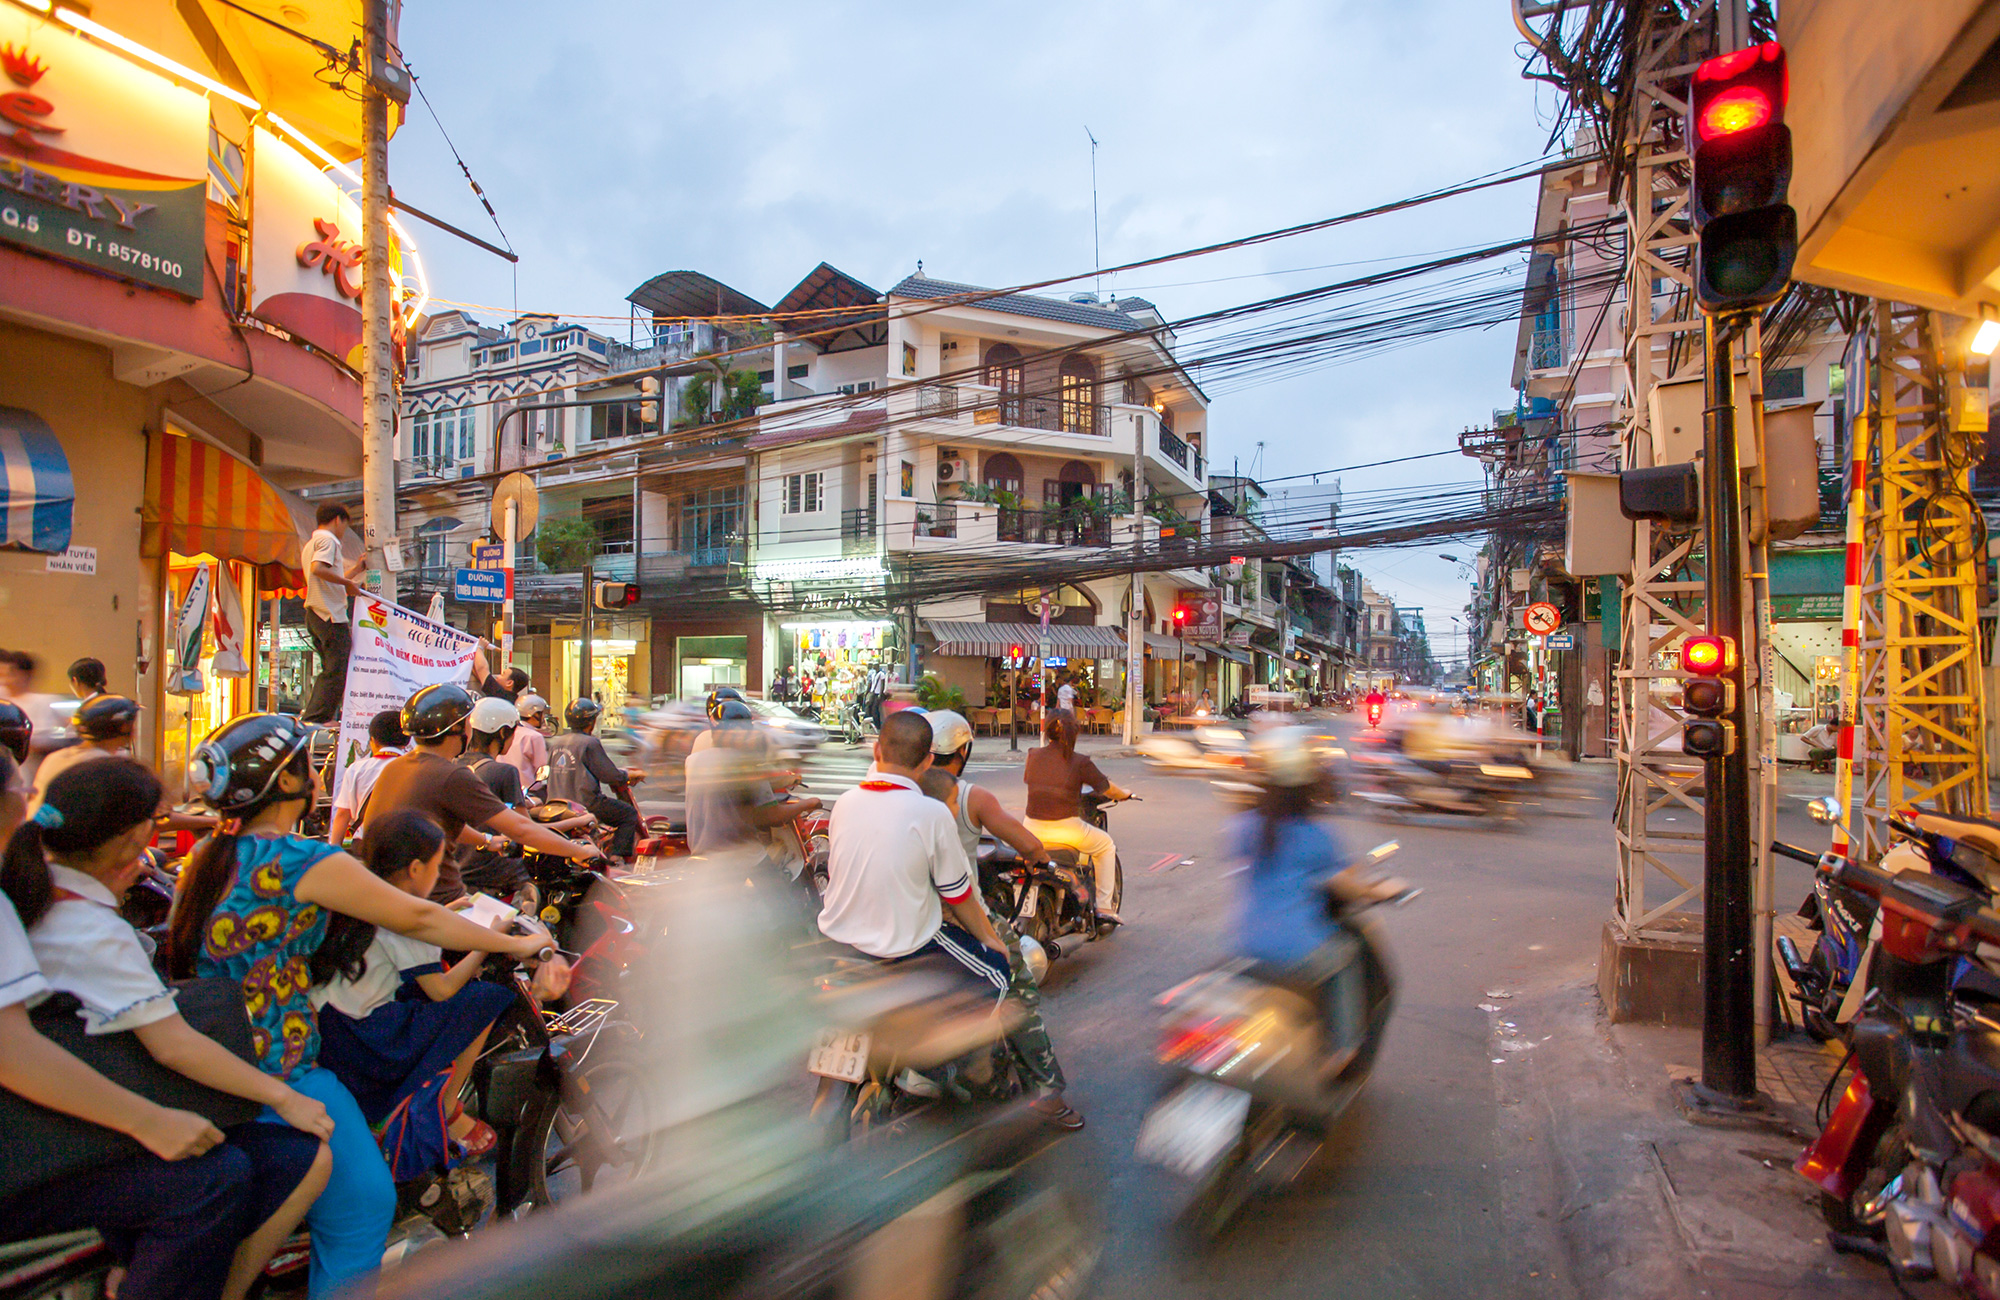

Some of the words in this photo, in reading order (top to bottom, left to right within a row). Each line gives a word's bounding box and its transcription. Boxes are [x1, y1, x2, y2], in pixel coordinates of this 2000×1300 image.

[2, 206, 40, 234] Q.5
[108, 241, 183, 279] 8578100
[468, 573, 494, 583] ĐƯỜNG
[1033, 603, 1061, 618] 37
